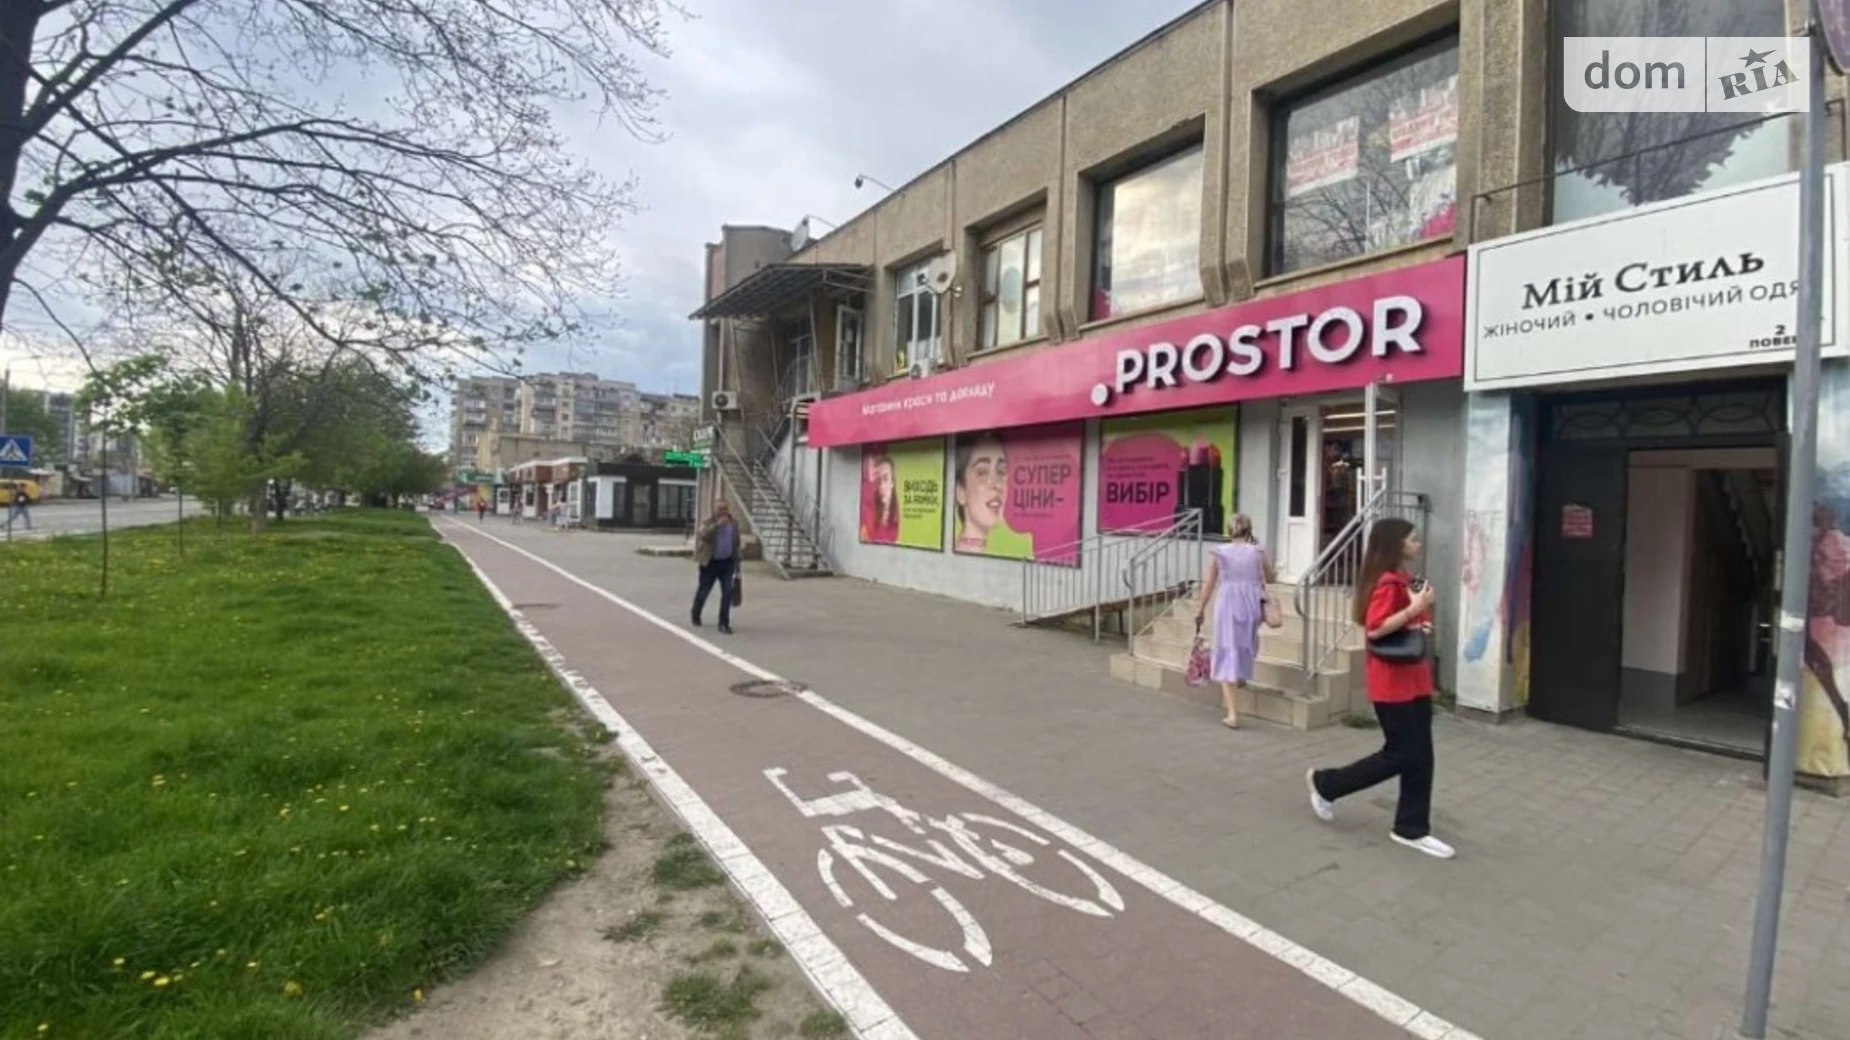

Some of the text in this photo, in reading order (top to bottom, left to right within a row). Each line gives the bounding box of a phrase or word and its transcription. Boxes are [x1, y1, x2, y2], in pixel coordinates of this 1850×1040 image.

[1521, 251, 1765, 310] Мій Стиль
[1603, 285, 1743, 321] ЧОЛОВІЧИЙ
[1749, 280, 1799, 303] ОДЯ
[1774, 324, 1786, 336] 2
[1748, 335, 1797, 349] ПОВЕ
[1014, 464, 1072, 486] СУПЕР
[1106, 481, 1170, 504] ВИБІР
